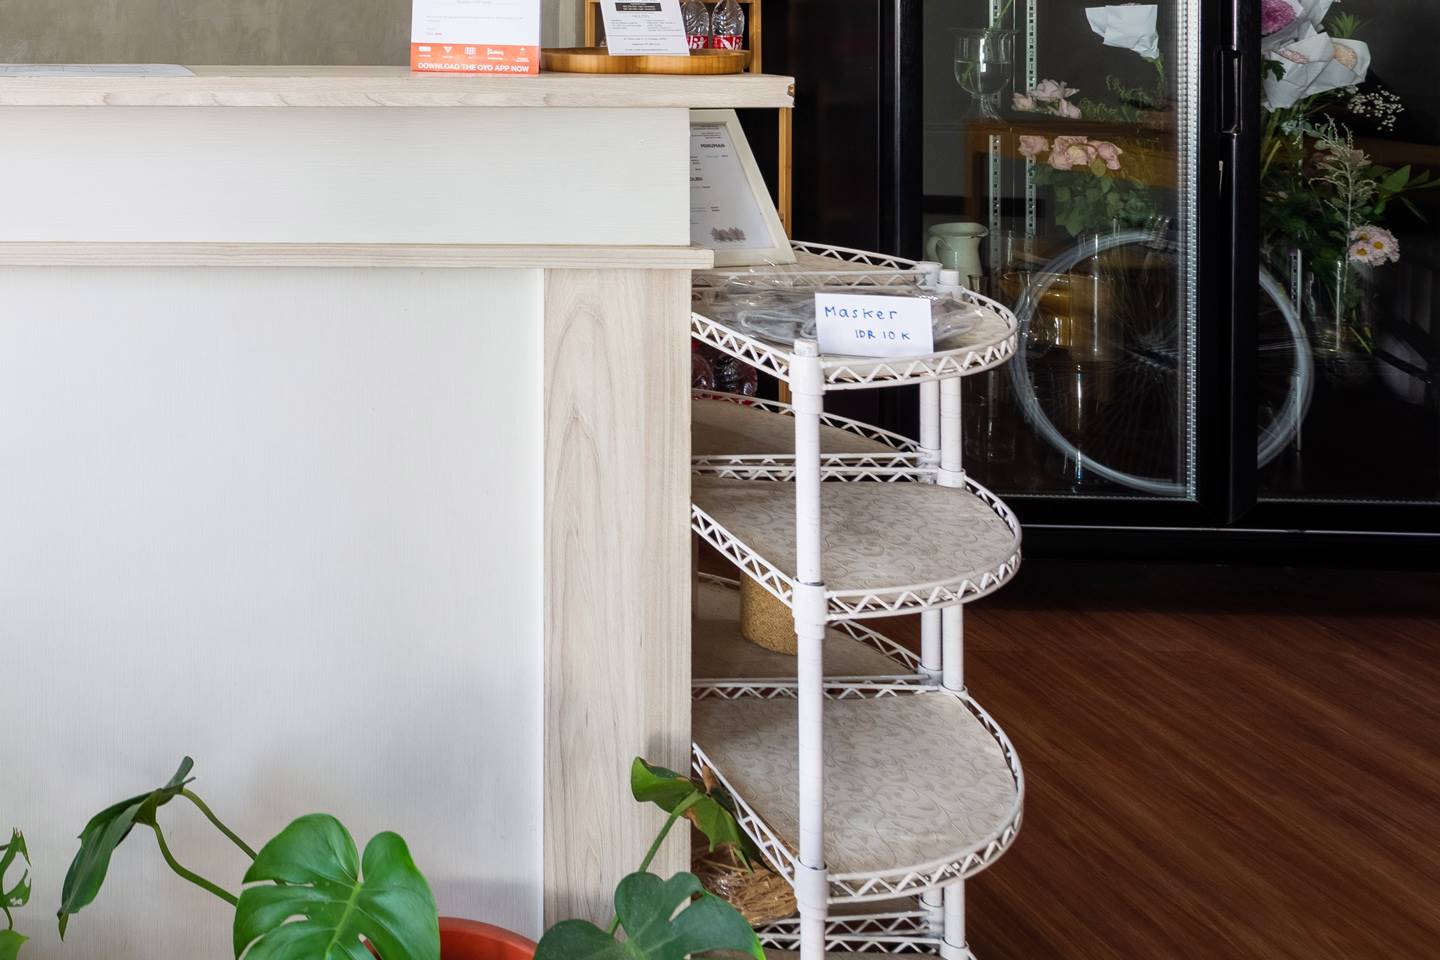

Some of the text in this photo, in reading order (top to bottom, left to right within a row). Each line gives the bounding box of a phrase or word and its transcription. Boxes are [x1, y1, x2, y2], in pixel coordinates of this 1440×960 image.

[417, 62, 459, 70] DOWNLOAD
[824, 306, 898, 320] Masker
[855, 329, 876, 340] IDR
[883, 330, 896, 340] 10
